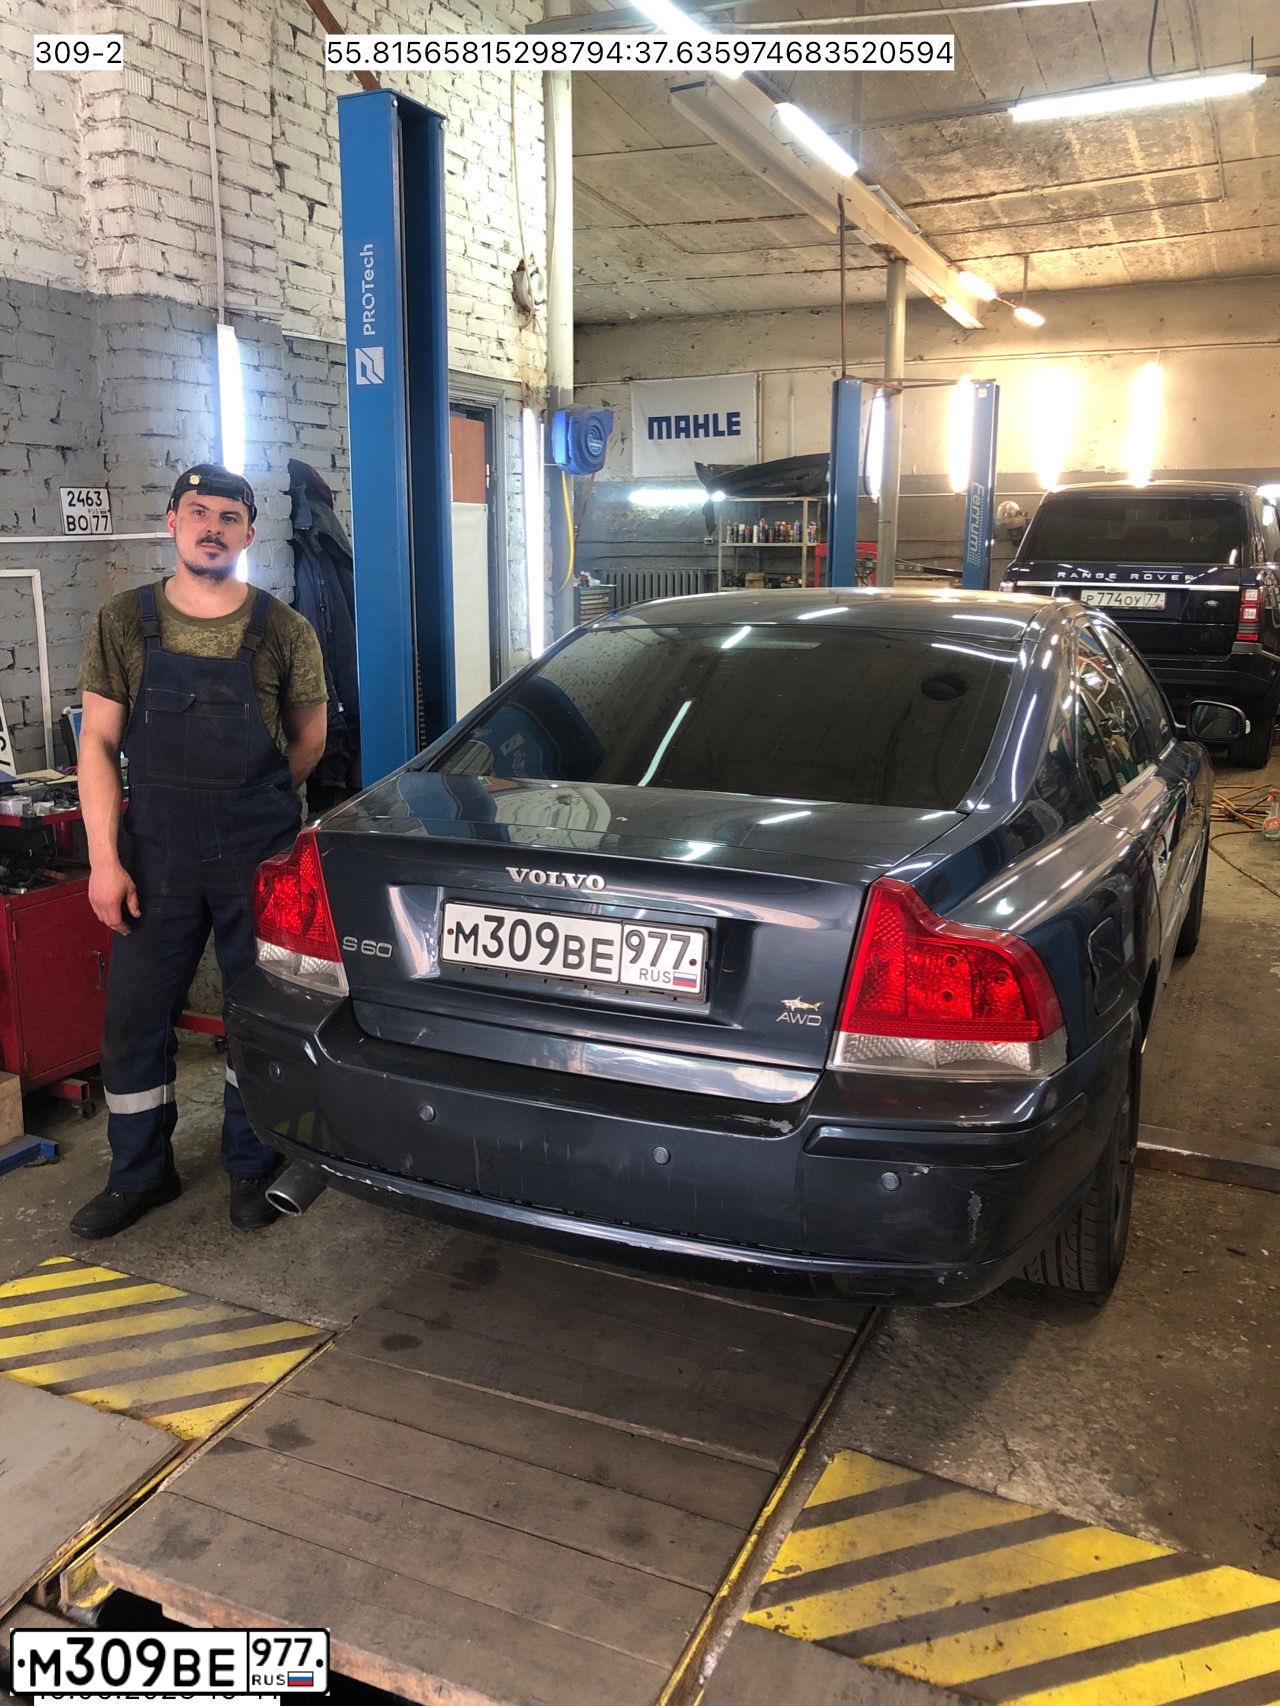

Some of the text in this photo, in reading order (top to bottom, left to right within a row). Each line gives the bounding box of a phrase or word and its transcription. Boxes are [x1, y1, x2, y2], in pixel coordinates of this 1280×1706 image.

[359, 243, 376, 336] PROTech
[648, 412, 741, 440] MAHLE
[67, 490, 102, 507] 2463
[92, 515, 108, 531] 77
[1057, 572, 1194, 582] RANGE ROVER
[506, 867, 606, 891] VOLVO
[454, 915, 691, 975] М309ВЕ 977
[639, 967, 672, 984] RUS
[776, 1012, 822, 1026] AWD
